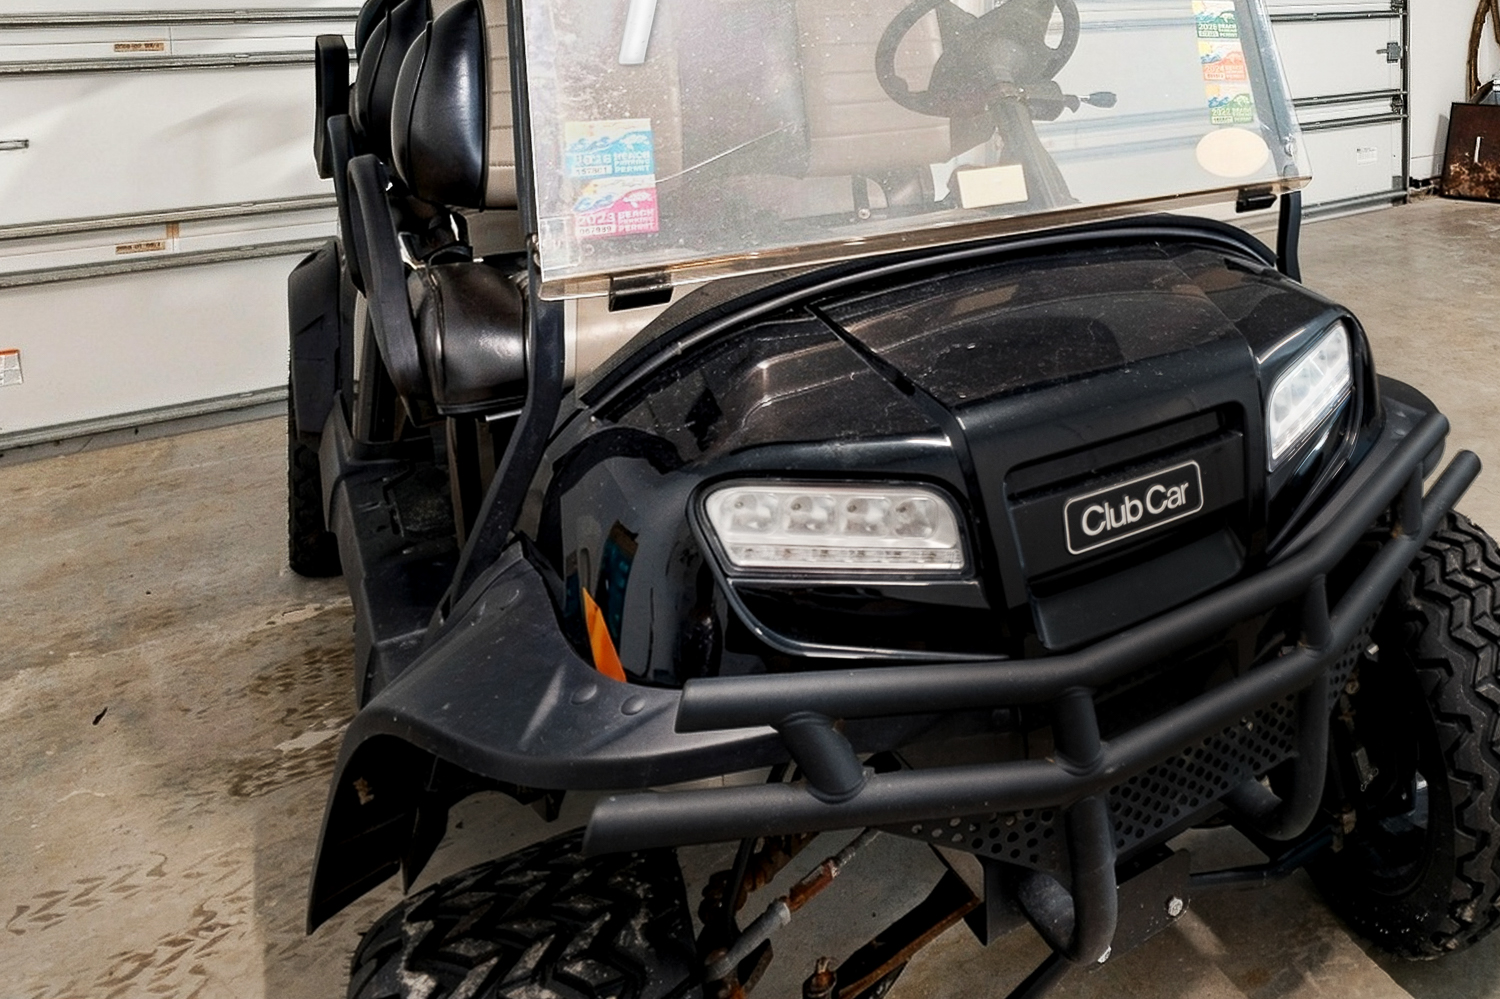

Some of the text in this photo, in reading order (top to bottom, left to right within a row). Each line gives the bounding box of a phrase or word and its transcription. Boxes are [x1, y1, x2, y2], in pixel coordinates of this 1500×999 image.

[614, 165, 650, 174] PERMIT
[579, 212, 616, 225] 2023
[618, 209, 654, 220] BEACH
[618, 223, 655, 232] PERMIT
[1082, 483, 1189, 536] Club Car
